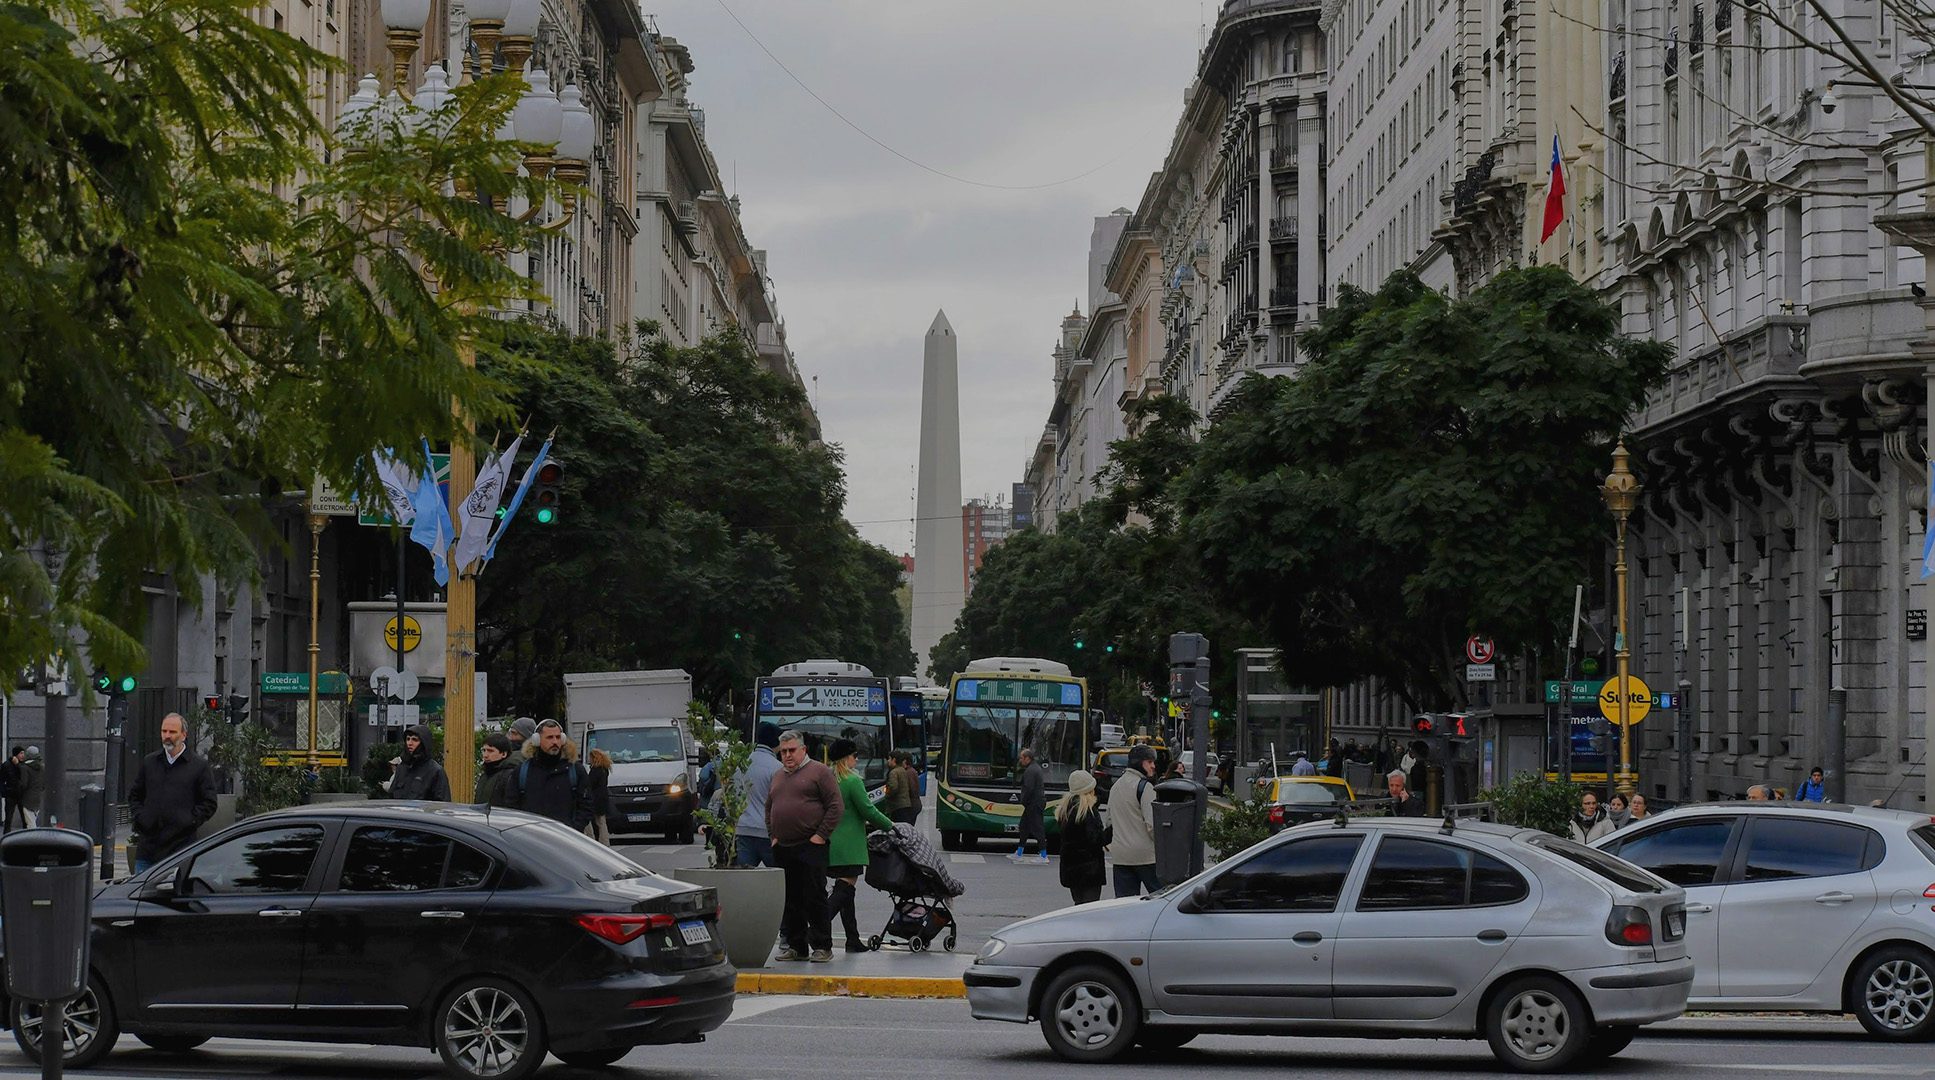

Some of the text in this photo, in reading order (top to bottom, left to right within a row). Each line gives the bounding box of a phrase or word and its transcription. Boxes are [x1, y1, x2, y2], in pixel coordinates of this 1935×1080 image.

[390, 626, 417, 636] Ste
[265, 676, 300, 684] Catedral
[980, 680, 1054, 703] 111
[1550, 684, 1588, 693] Cadral
[773, 688, 820, 708] 24
[823, 689, 865, 698] WILDE
[828, 699, 841, 707] DEL
[843, 699, 868, 708] PARQUE
[1652, 696, 1660, 705] D
[1672, 697, 1678, 705] E
